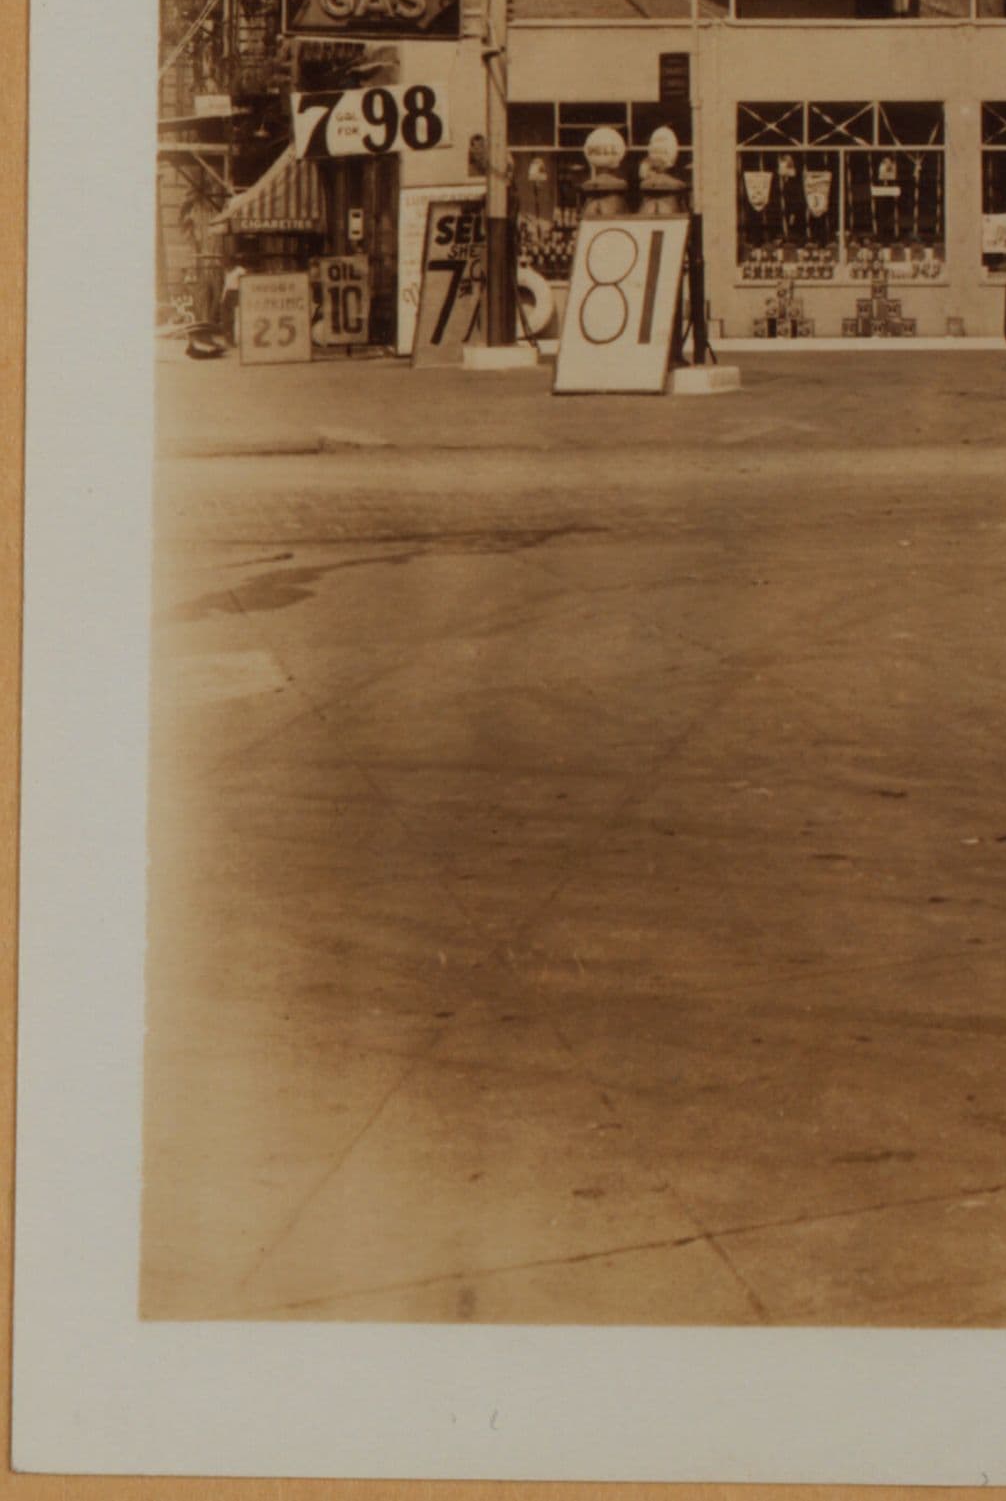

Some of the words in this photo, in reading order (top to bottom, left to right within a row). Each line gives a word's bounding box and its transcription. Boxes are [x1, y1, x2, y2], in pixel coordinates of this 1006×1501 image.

[297, 92, 345, 159] 7
[361, 85, 443, 153] 98
[328, 264, 361, 281] OIL
[253, 316, 297, 348] 25
